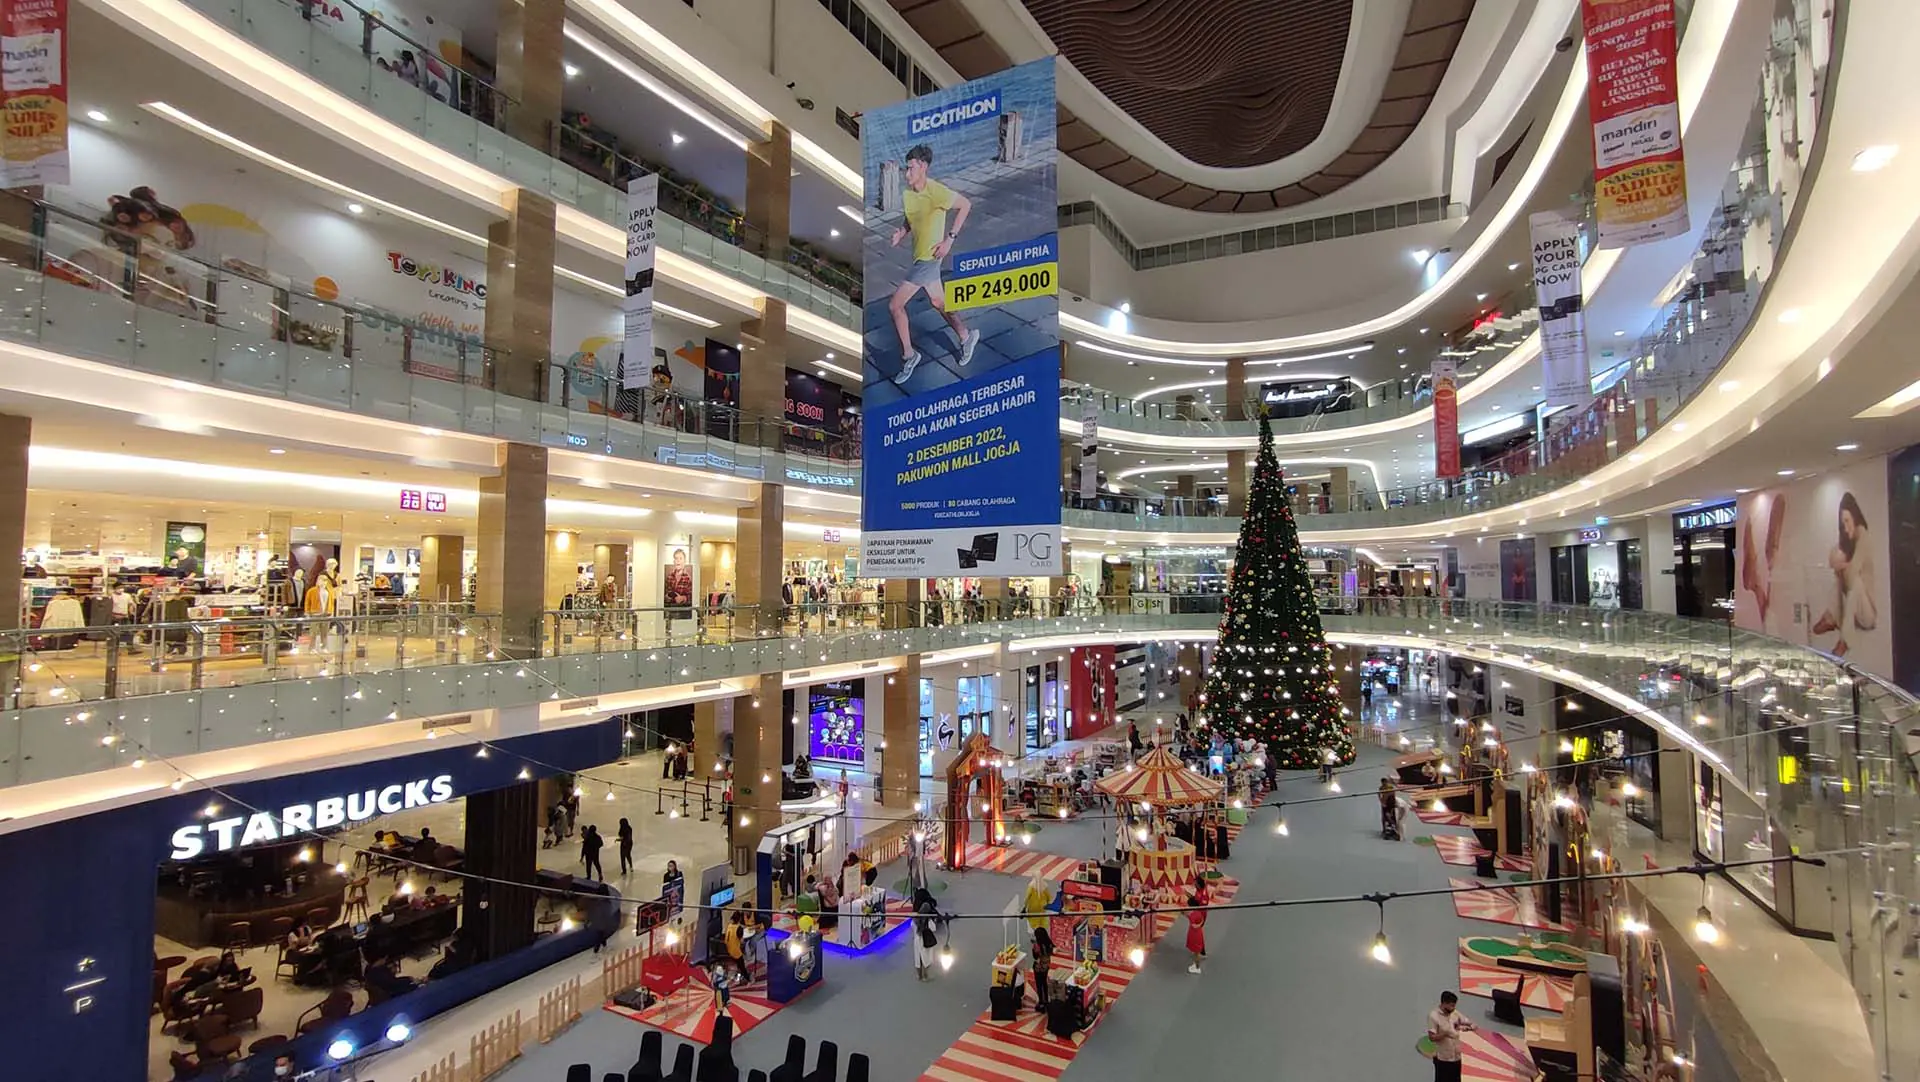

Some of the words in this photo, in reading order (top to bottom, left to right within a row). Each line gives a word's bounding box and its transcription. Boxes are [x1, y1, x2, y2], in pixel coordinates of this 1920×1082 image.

[1588, 17, 1625, 36] GRAND
[1627, 4, 1670, 23] ATRIUM
[1616, 36, 1646, 52] 2022
[1601, 48, 1660, 73] BELANJA
[1602, 84, 1666, 107] LANGSUNG
[912, 96, 997, 134] DECATHLON
[1601, 119, 1657, 142] mandiri
[1604, 163, 1675, 184] SAKSIKAN
[1616, 183, 1679, 206] SULAP
[637, 232, 655, 242] CARD
[1534, 236, 1577, 252] APPLY
[959, 254, 997, 272] SEPATU
[999, 250, 1022, 265] LARI
[1024, 244, 1050, 260] PRIA
[1535, 250, 1575, 264] YOUR
[1535, 265, 1549, 274] PG
[1552, 260, 1580, 272] CARD
[954, 283, 977, 303] RP
[982, 270, 1050, 299] 249.000
[1535, 272, 1572, 286] NOW
[429, 289, 469, 309] Creating
[796, 401, 823, 421] SOON
[887, 411, 912, 429] TOKO
[915, 393, 969, 418] OLAHRAGA
[971, 375, 1025, 403] TERBESAR
[884, 433, 893, 447] DI
[895, 426, 927, 443] JOGJA
[929, 417, 957, 434] AKAN
[959, 404, 999, 424] SEGERA
[1002, 390, 1036, 411] HADIR
[907, 453, 914, 465] 2
[916, 435, 973, 463] DESEMBER
[976, 426, 1007, 446] 2022,
[896, 460, 949, 486] PAKUWON
[951, 455, 981, 472] MALL
[983, 440, 1021, 462] JOGJA
[901, 502, 915, 510] 5000
[916, 501, 939, 509] PRODUK
[956, 498, 981, 507] CABANG
[981, 496, 1016, 506] OLAHRAGA
[1012, 532, 1052, 560] PG
[170, 775, 453, 860] STARBUCKS
